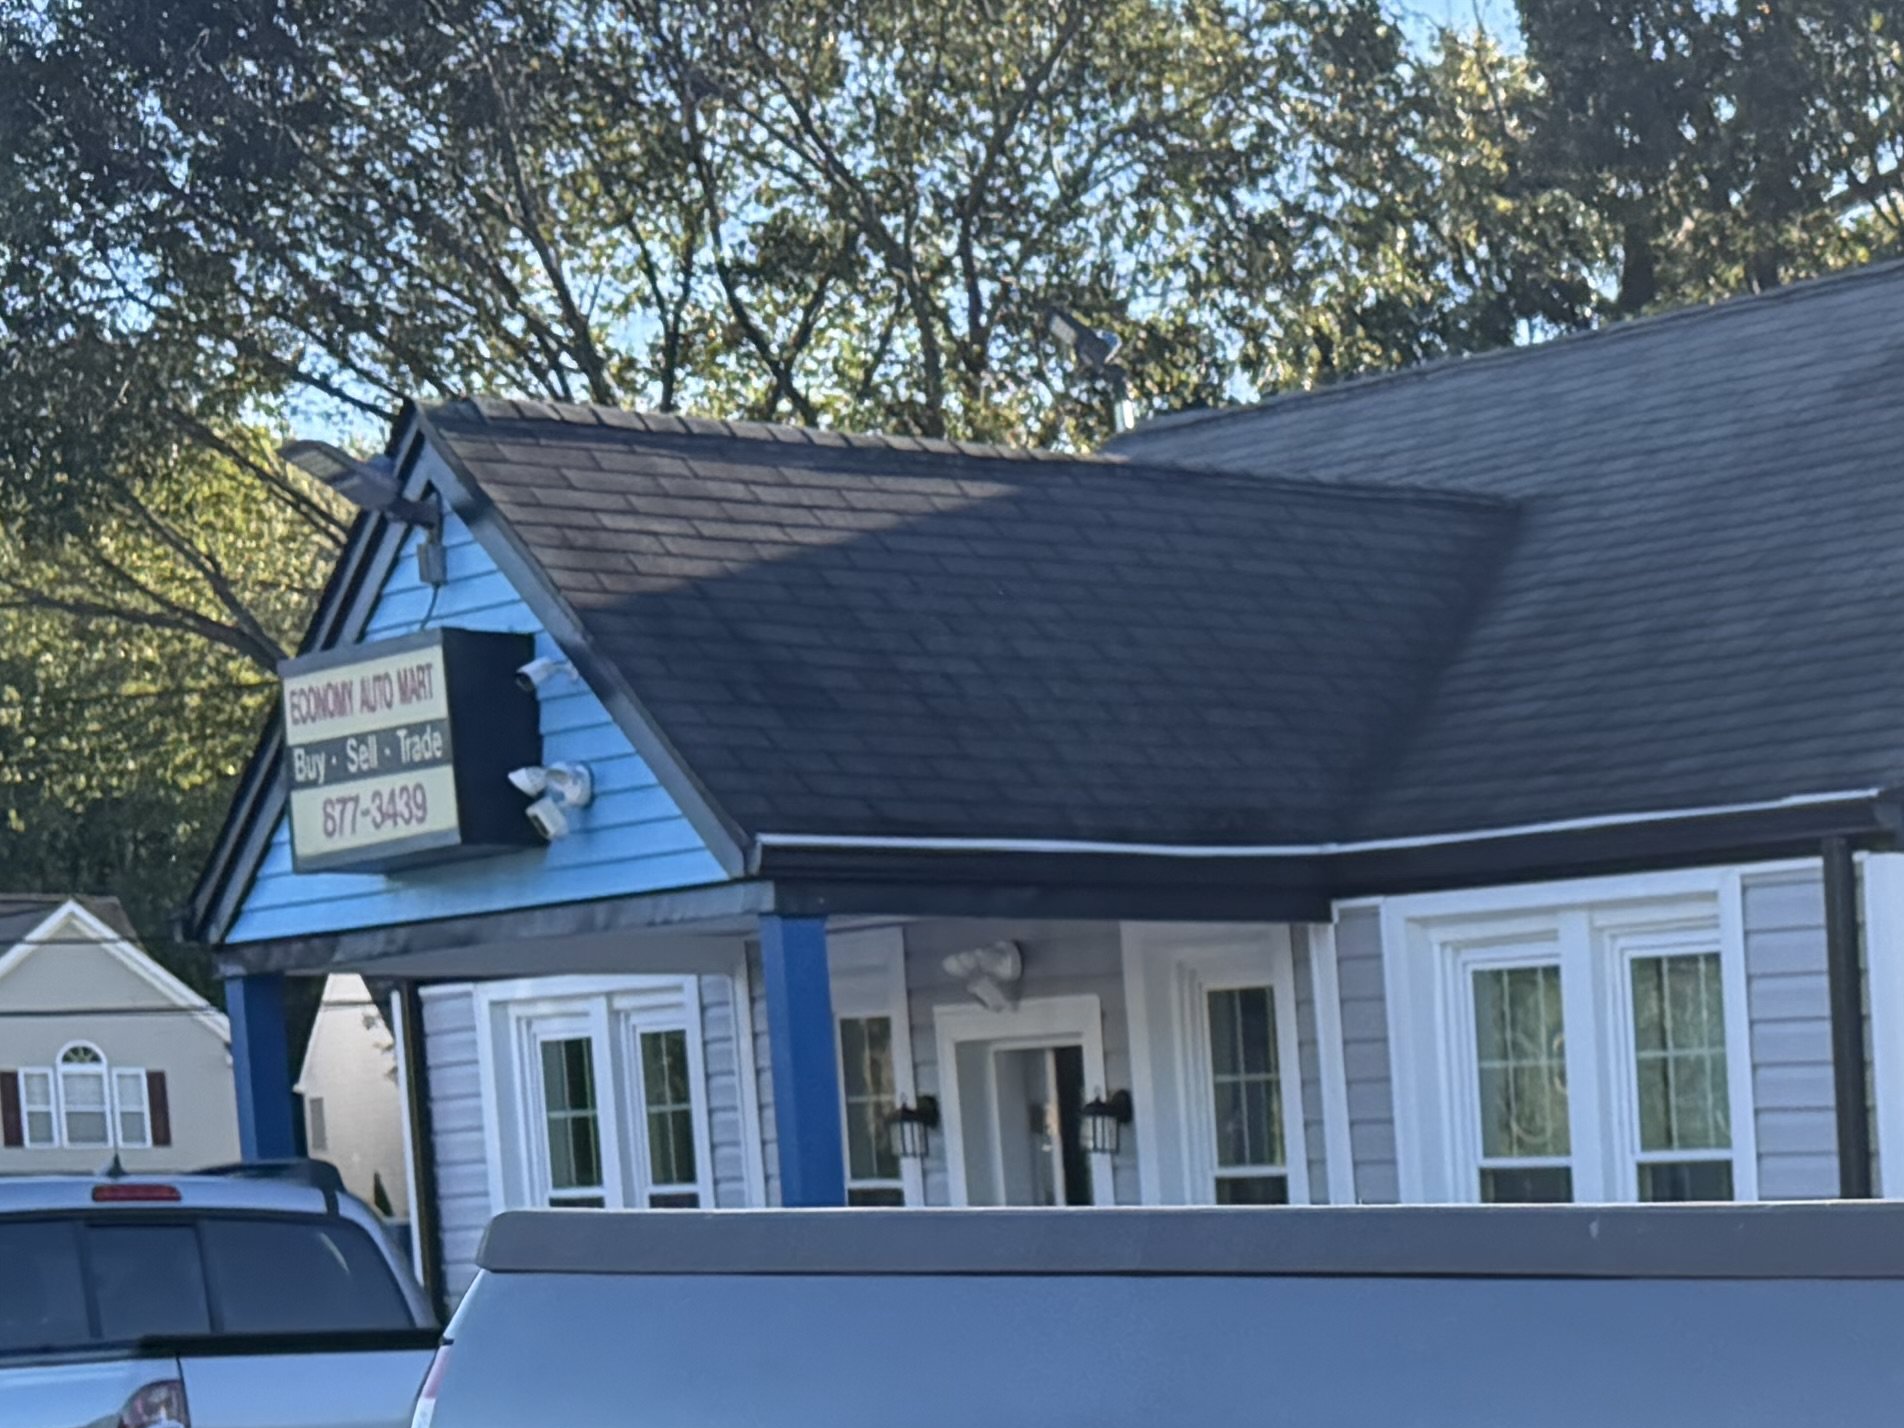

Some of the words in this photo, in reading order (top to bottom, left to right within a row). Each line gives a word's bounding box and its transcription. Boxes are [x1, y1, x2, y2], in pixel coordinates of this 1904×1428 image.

[290, 679, 353, 726] ECONOMY
[360, 671, 394, 714] AUTO
[397, 663, 433, 705] MART
[293, 748, 326, 784] Buy
[346, 735, 378, 773] Sell
[396, 725, 443, 764] Trade
